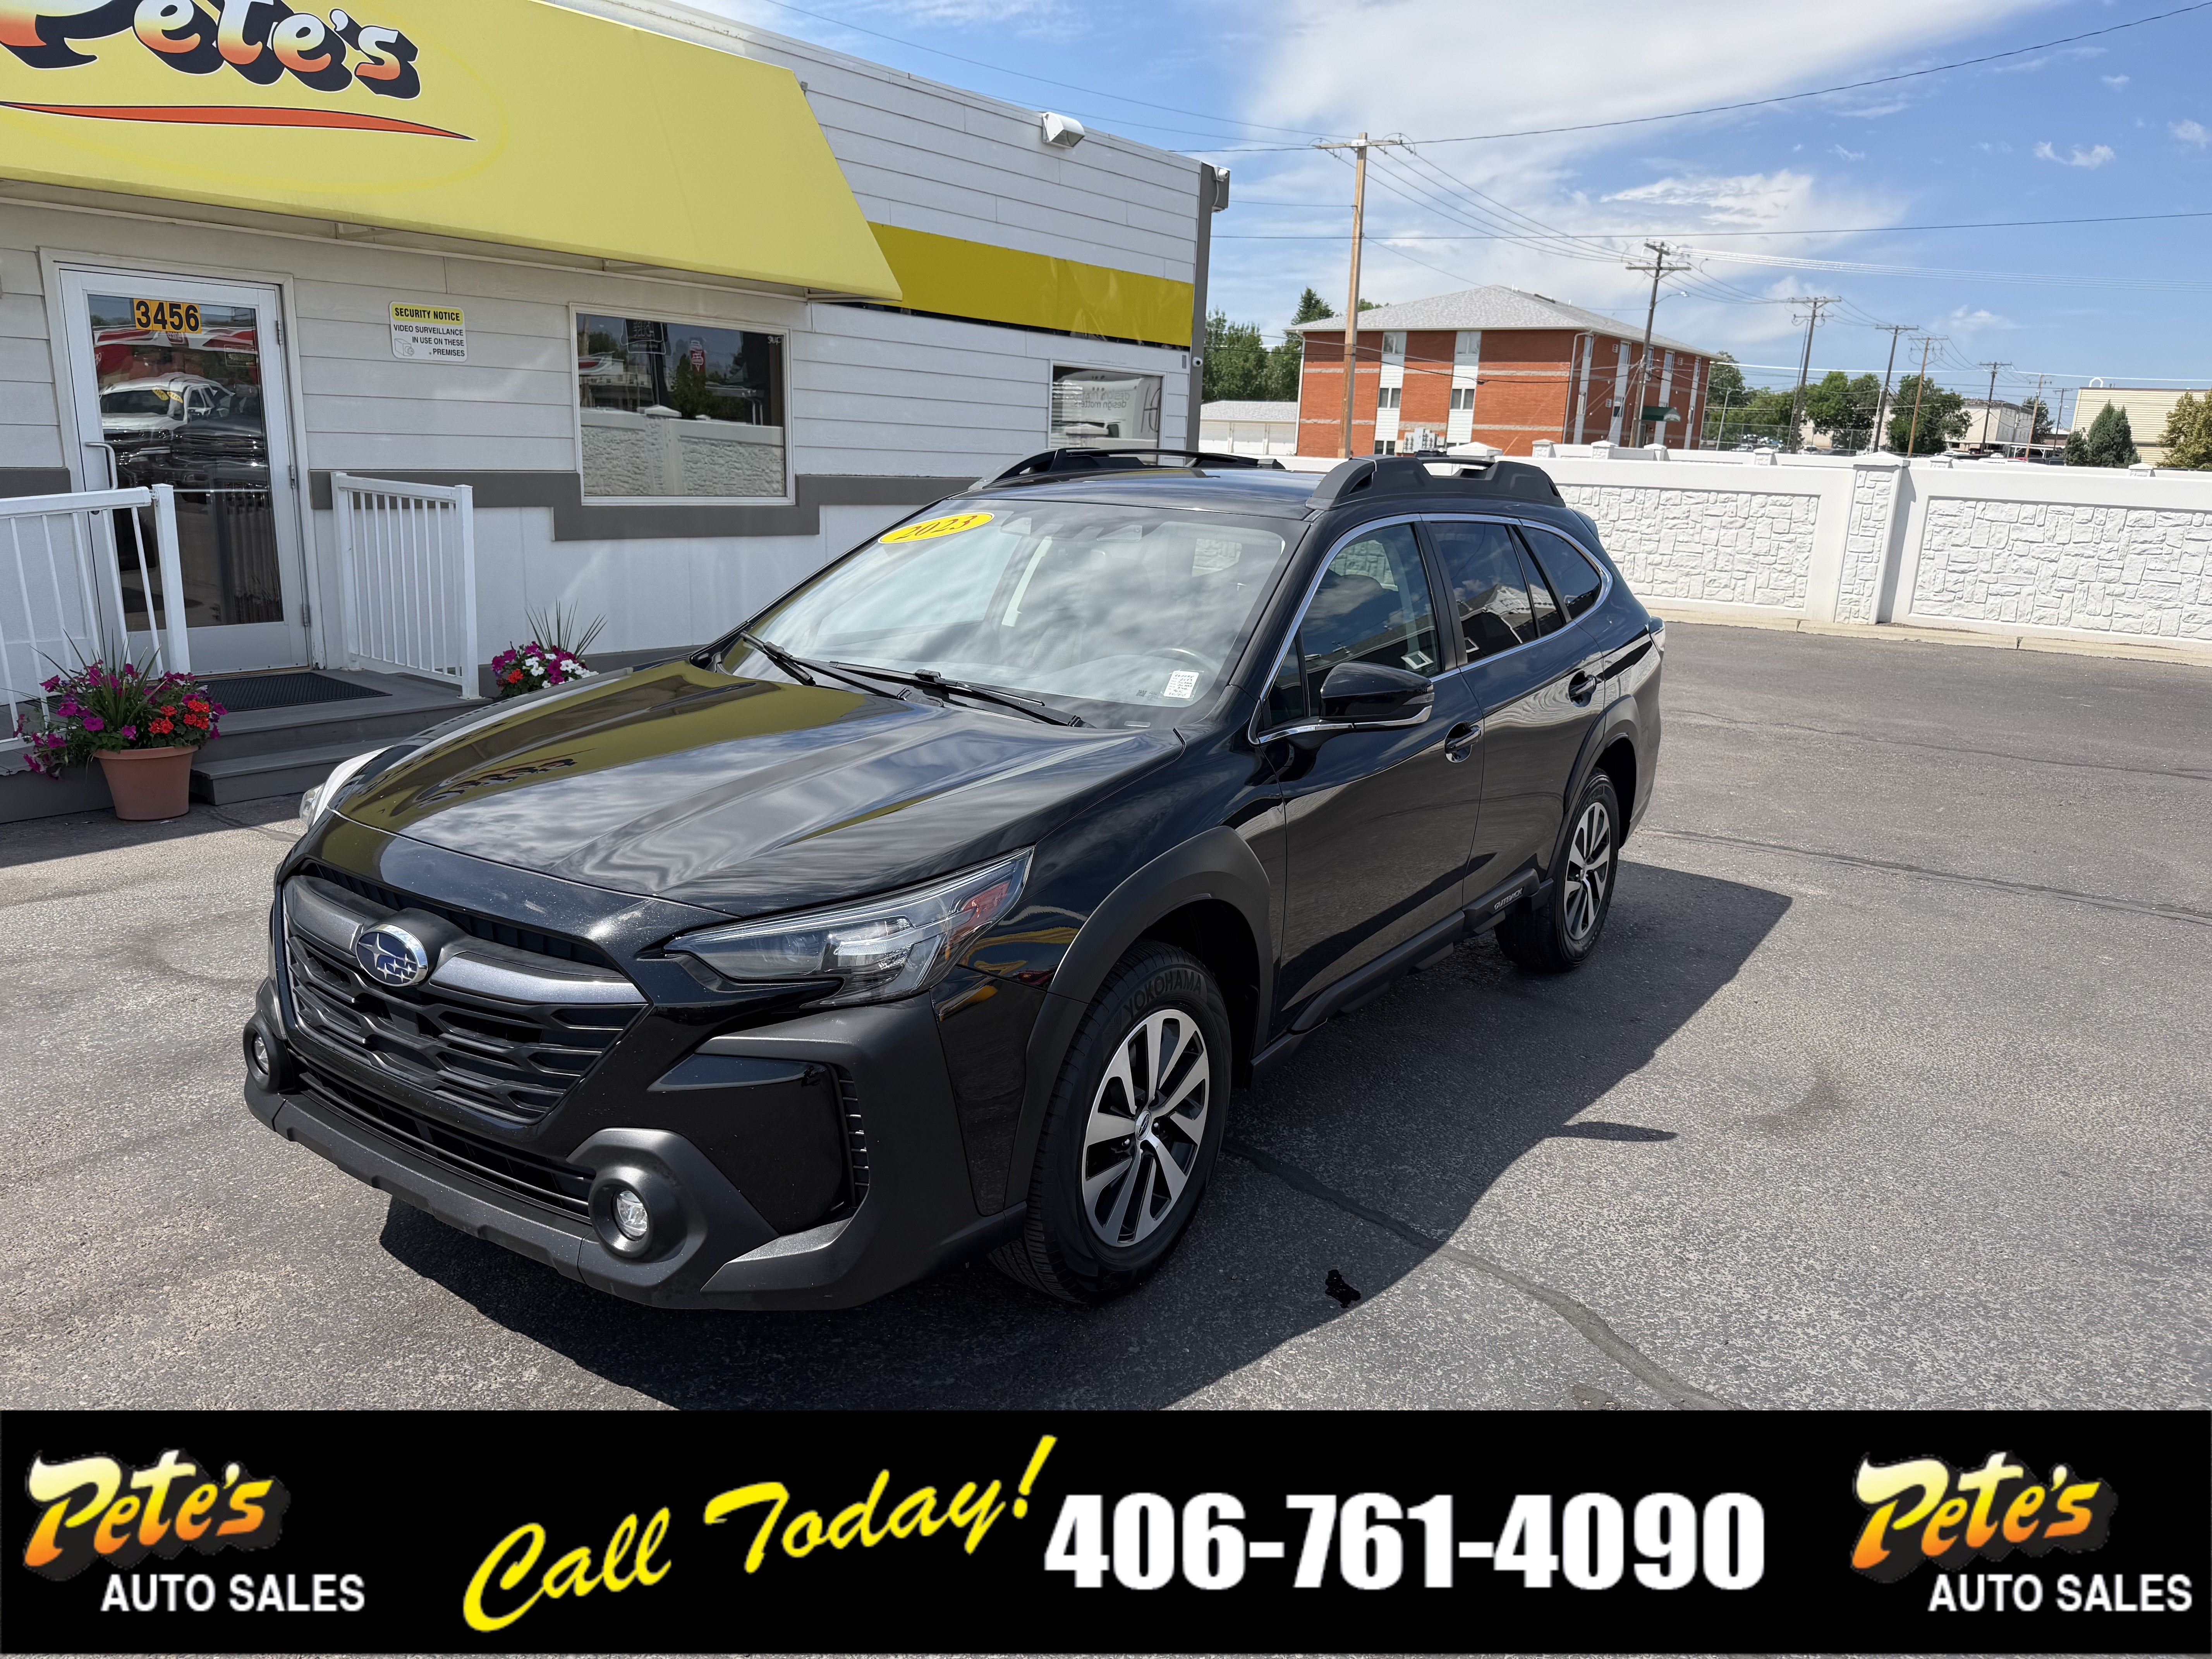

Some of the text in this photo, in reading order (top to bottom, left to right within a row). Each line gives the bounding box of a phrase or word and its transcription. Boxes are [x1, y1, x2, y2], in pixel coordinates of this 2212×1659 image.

[136, 301, 200, 332] 3456
[395, 307, 460, 321] SECURITY NOTICE
[415, 326, 464, 336] SURVEILLANCE
[433, 348, 465, 357] PREMISES
[893, 515, 978, 541] 2023
[1494, 888, 1523, 910] OUTBACK
[1123, 969, 1202, 1018] YOKOHAMA
